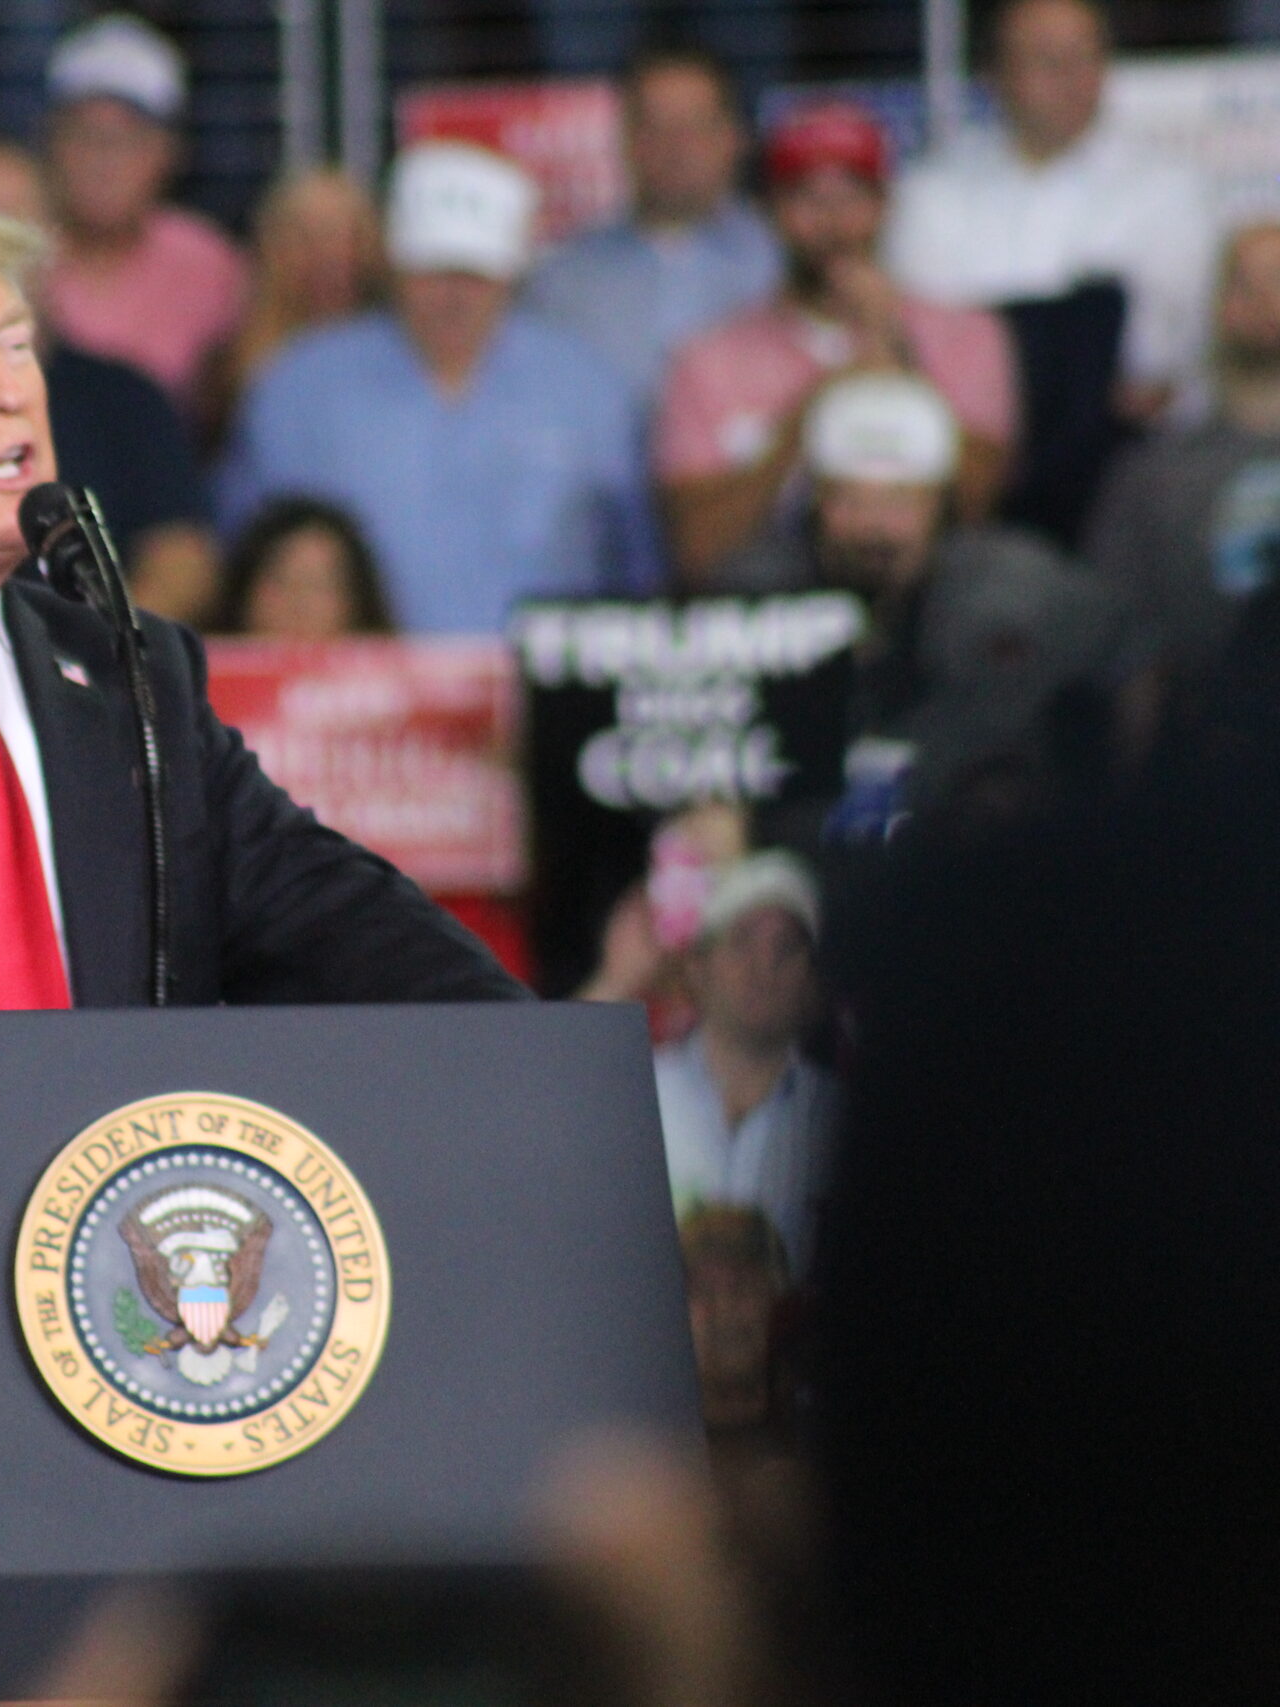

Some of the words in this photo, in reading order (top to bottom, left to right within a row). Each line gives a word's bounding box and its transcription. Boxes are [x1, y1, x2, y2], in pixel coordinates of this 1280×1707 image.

[196, 1112, 230, 1134] OF
[238, 1119, 285, 1156] THE
[30, 1109, 185, 1274] PRESIDENT
[292, 1152, 375, 1304] UNITED
[35, 1290, 63, 1341] THE
[51, 1349, 80, 1378] OF
[83, 1378, 175, 1454] SEAL
[241, 1339, 361, 1453] STATES
